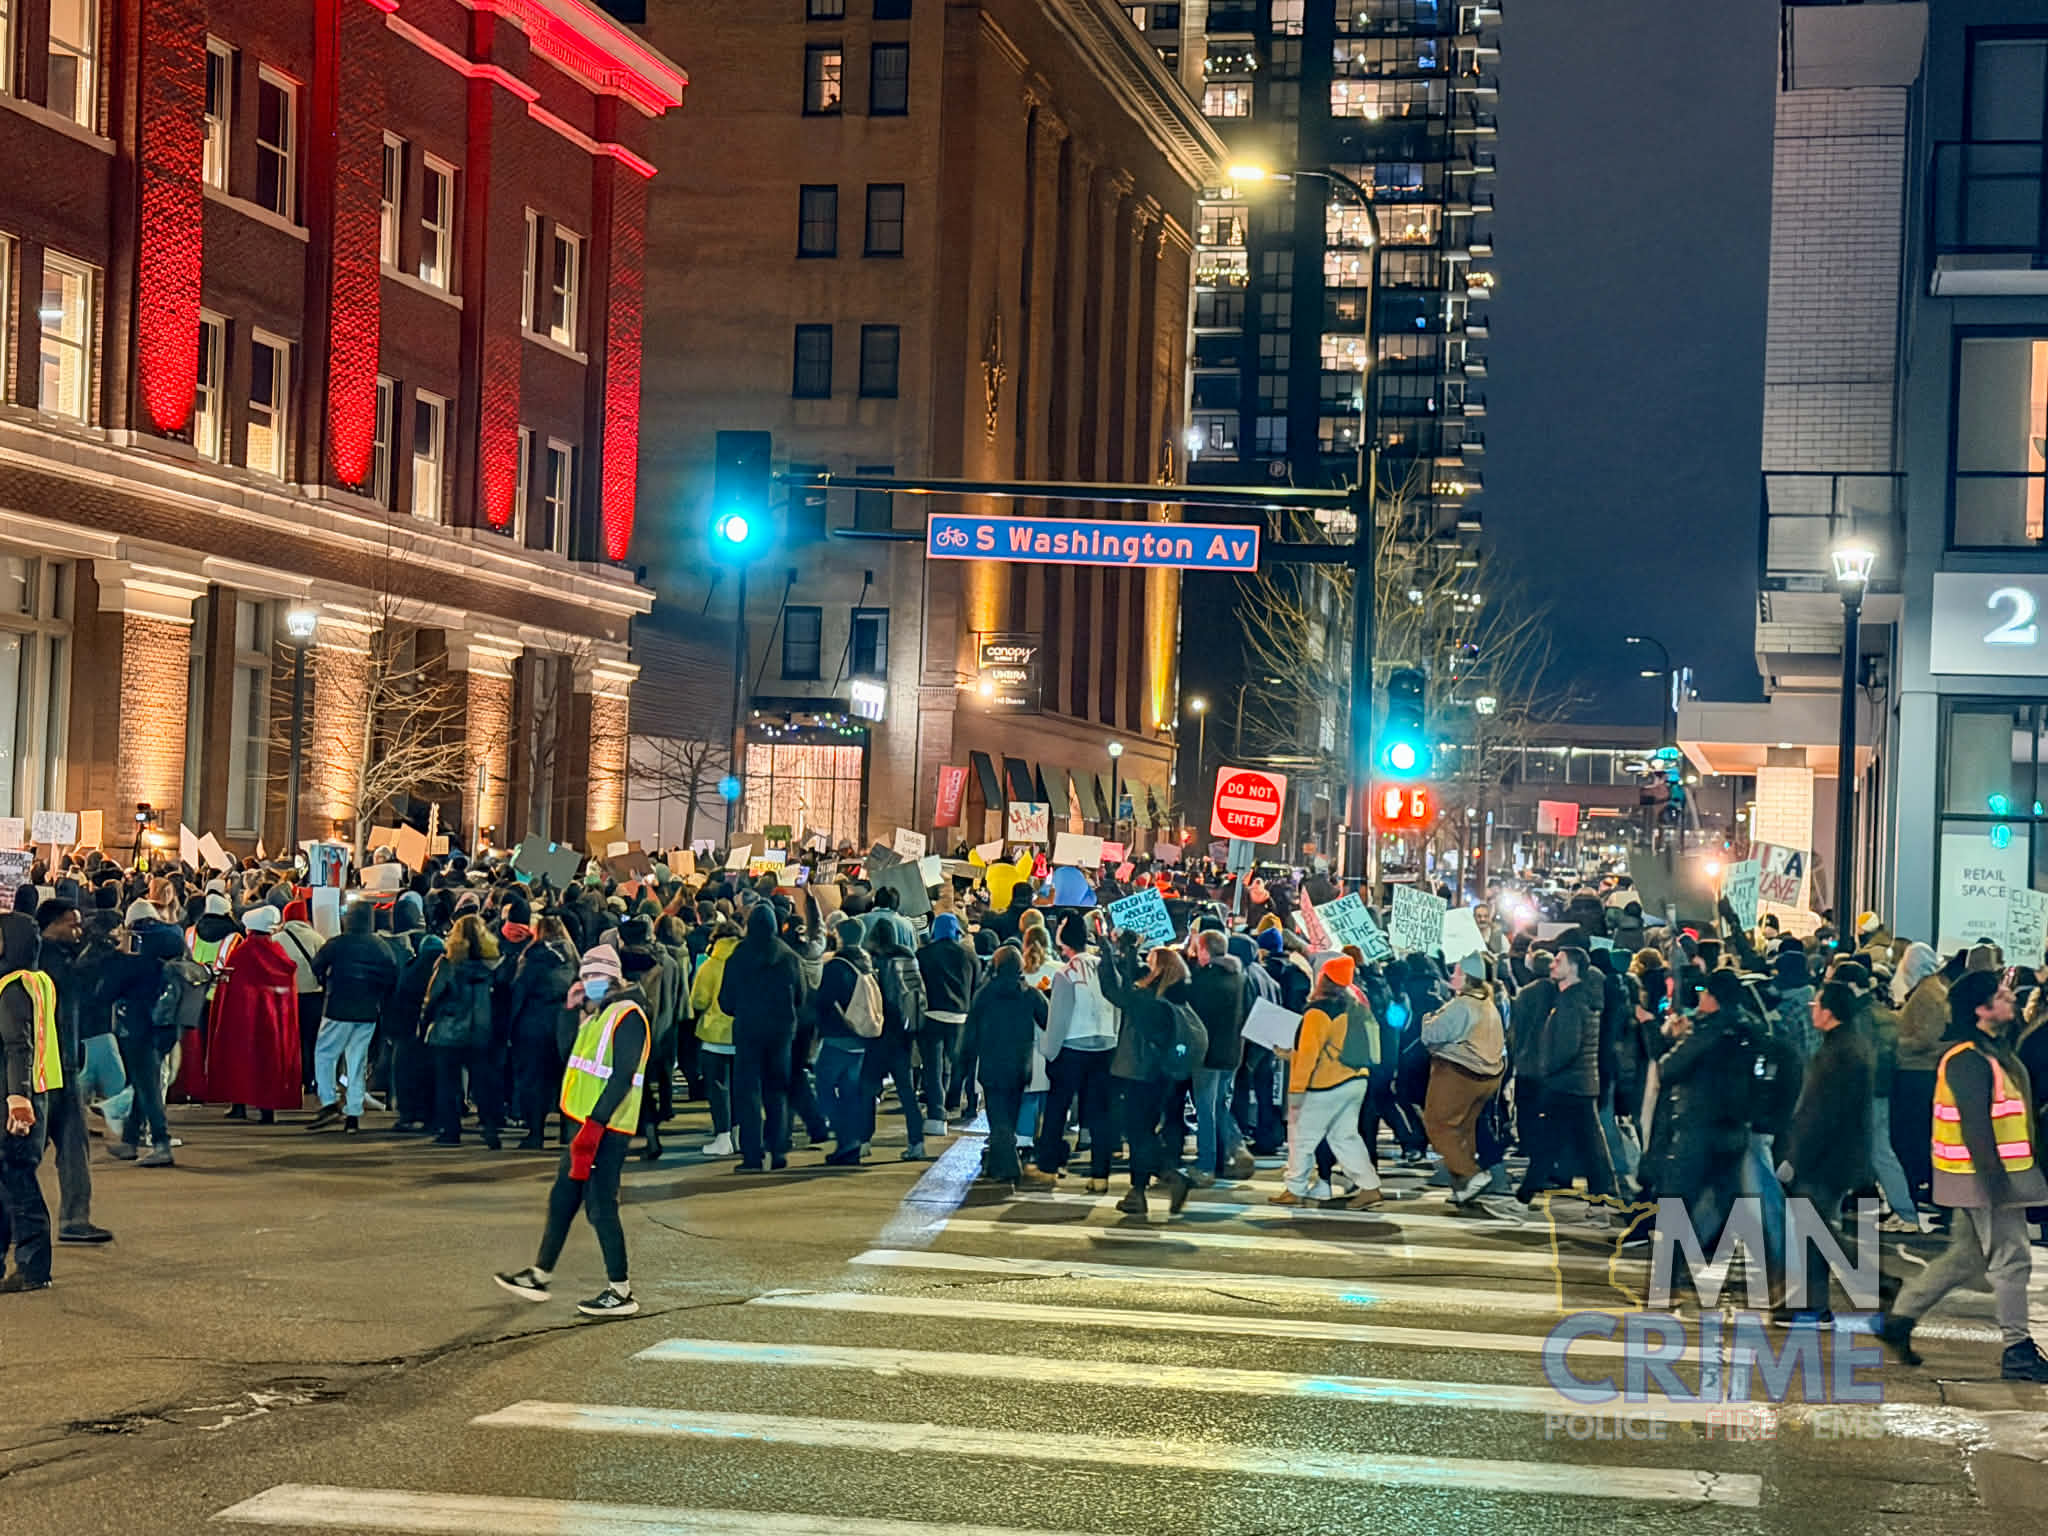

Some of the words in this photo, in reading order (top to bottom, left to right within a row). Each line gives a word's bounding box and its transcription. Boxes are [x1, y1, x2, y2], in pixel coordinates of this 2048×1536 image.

[976, 526, 995, 550] S
[1009, 526, 1193, 563] Washington
[1206, 535, 1249, 561] Av
[1983, 587, 2039, 644] 2
[987, 647, 1037, 664] canopy
[1228, 783, 1244, 795] DO
[1249, 785, 1274, 799] NOT
[1227, 813, 1265, 828] ENTER
[1963, 868, 2006, 881] RETAIL
[1961, 884, 2007, 898] SPACE
